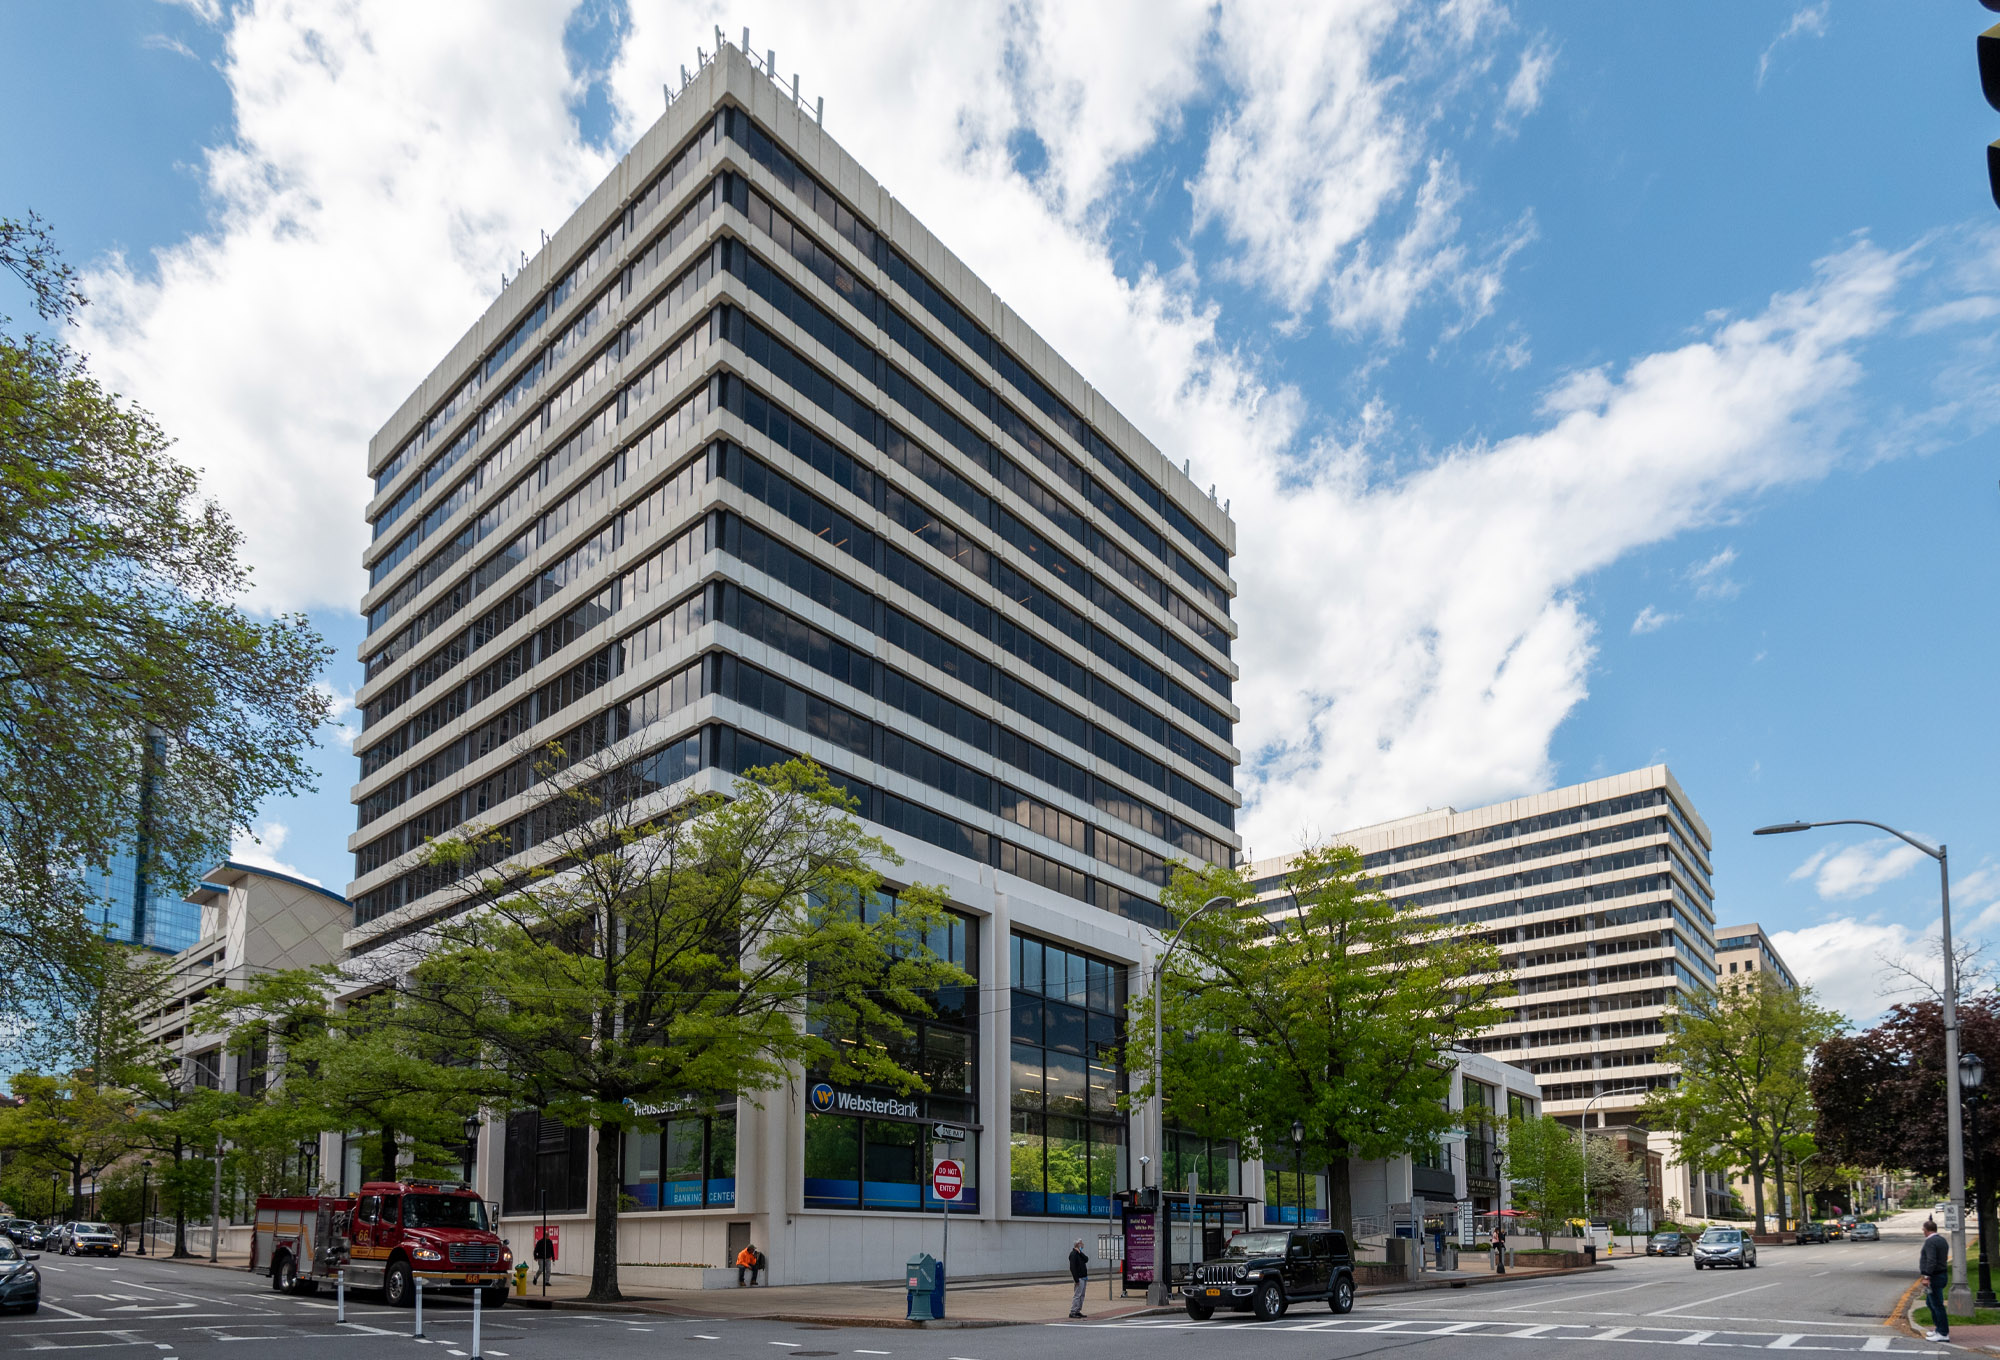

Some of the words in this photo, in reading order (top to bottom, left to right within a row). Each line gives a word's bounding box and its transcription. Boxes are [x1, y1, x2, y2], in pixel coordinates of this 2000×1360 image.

[838, 1092, 918, 1117] WebsterBank
[942, 1128, 952, 1136] ONE
[939, 1184, 956, 1192] ENTER
[673, 1192, 702, 1203] BANKING
[708, 1191, 735, 1201] CENTER
[1060, 1203, 1087, 1212] BANKING
[358, 1229, 369, 1242] 66
